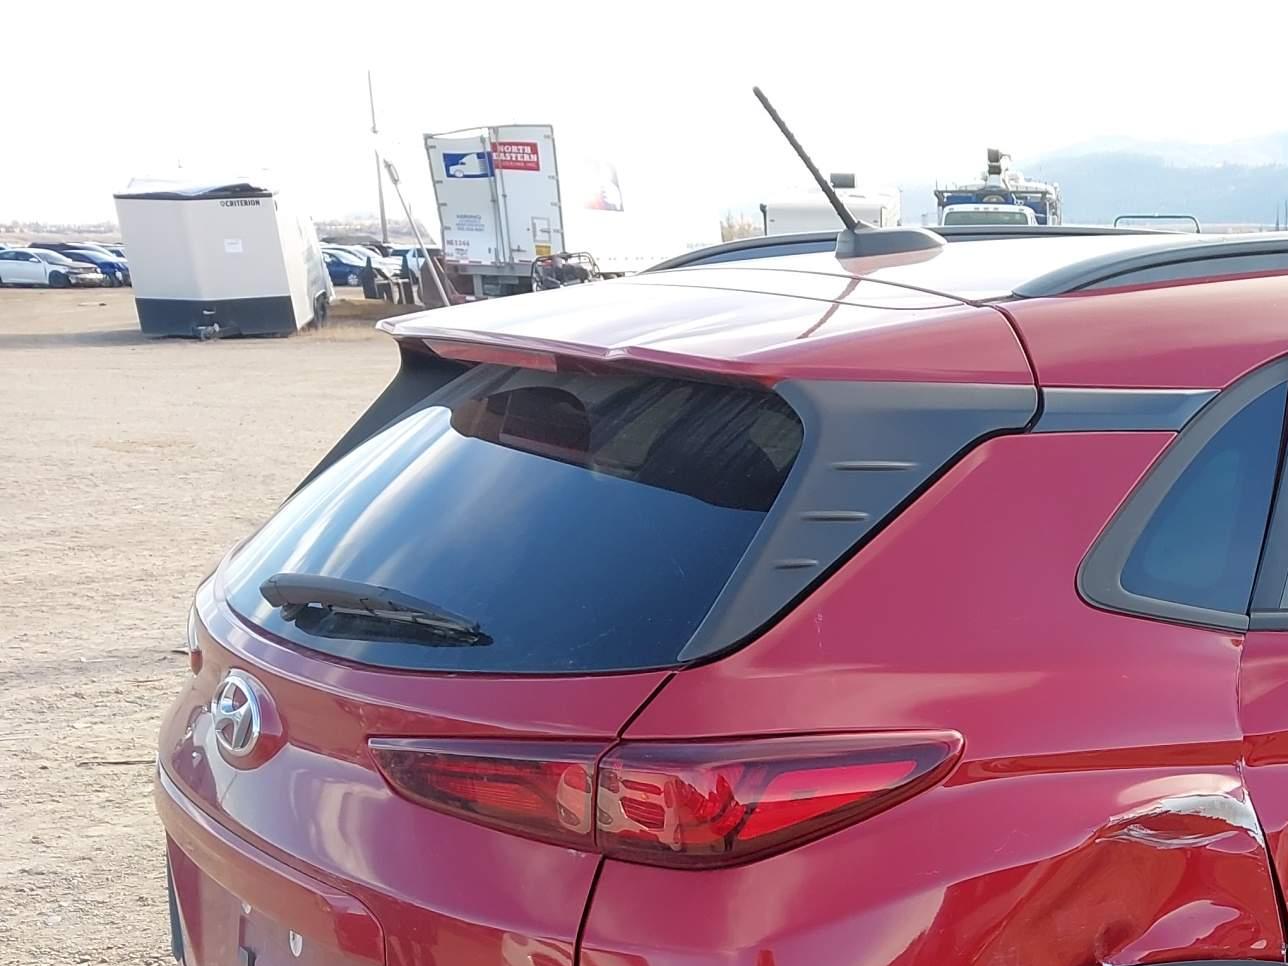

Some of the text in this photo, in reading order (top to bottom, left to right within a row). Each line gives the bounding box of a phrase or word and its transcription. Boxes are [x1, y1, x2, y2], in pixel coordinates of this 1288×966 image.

[497, 144, 531, 153] NORTH
[492, 152, 538, 162] EASTERN
[225, 199, 261, 207] CRITERION
